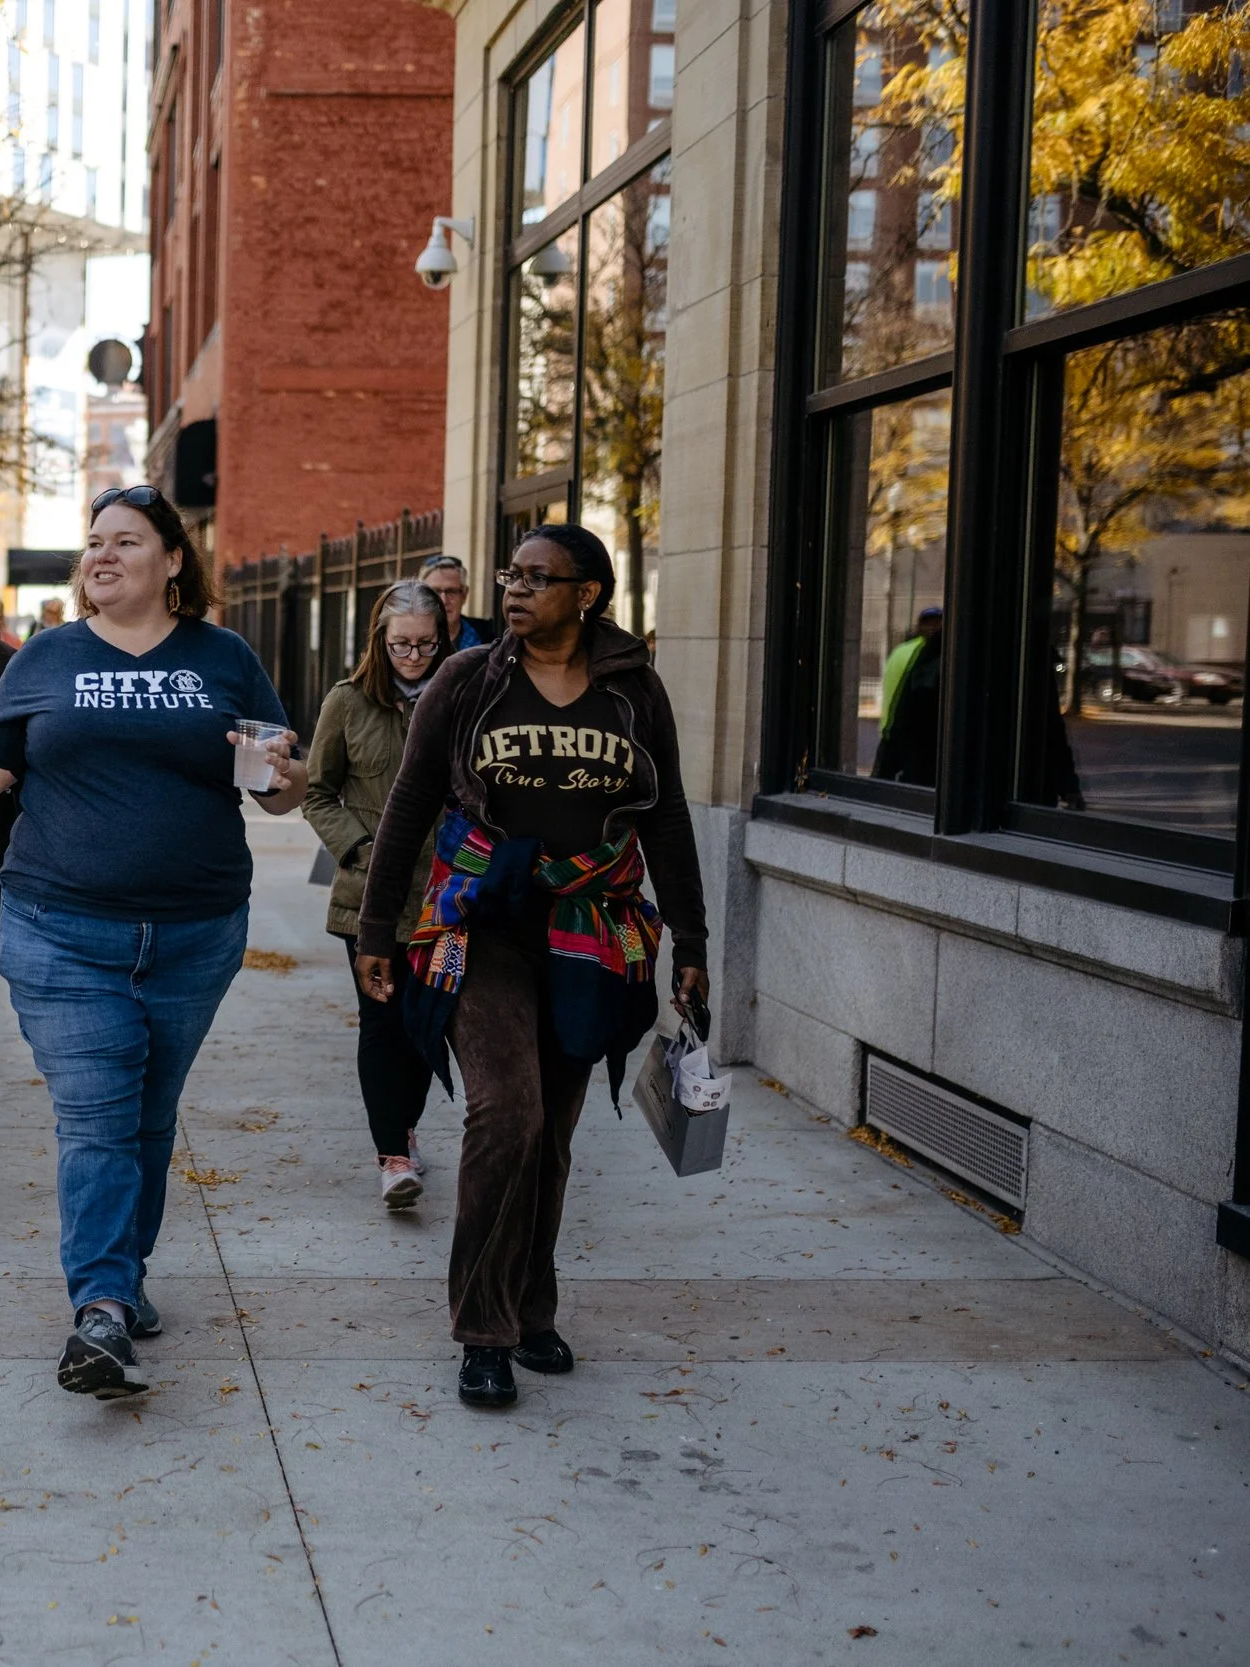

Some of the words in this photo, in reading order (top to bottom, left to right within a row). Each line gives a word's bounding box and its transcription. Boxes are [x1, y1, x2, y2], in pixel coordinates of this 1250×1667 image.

[75, 670, 168, 693] CITY
[74, 691, 214, 709] INSTITUTE
[488, 762, 547, 788] True
